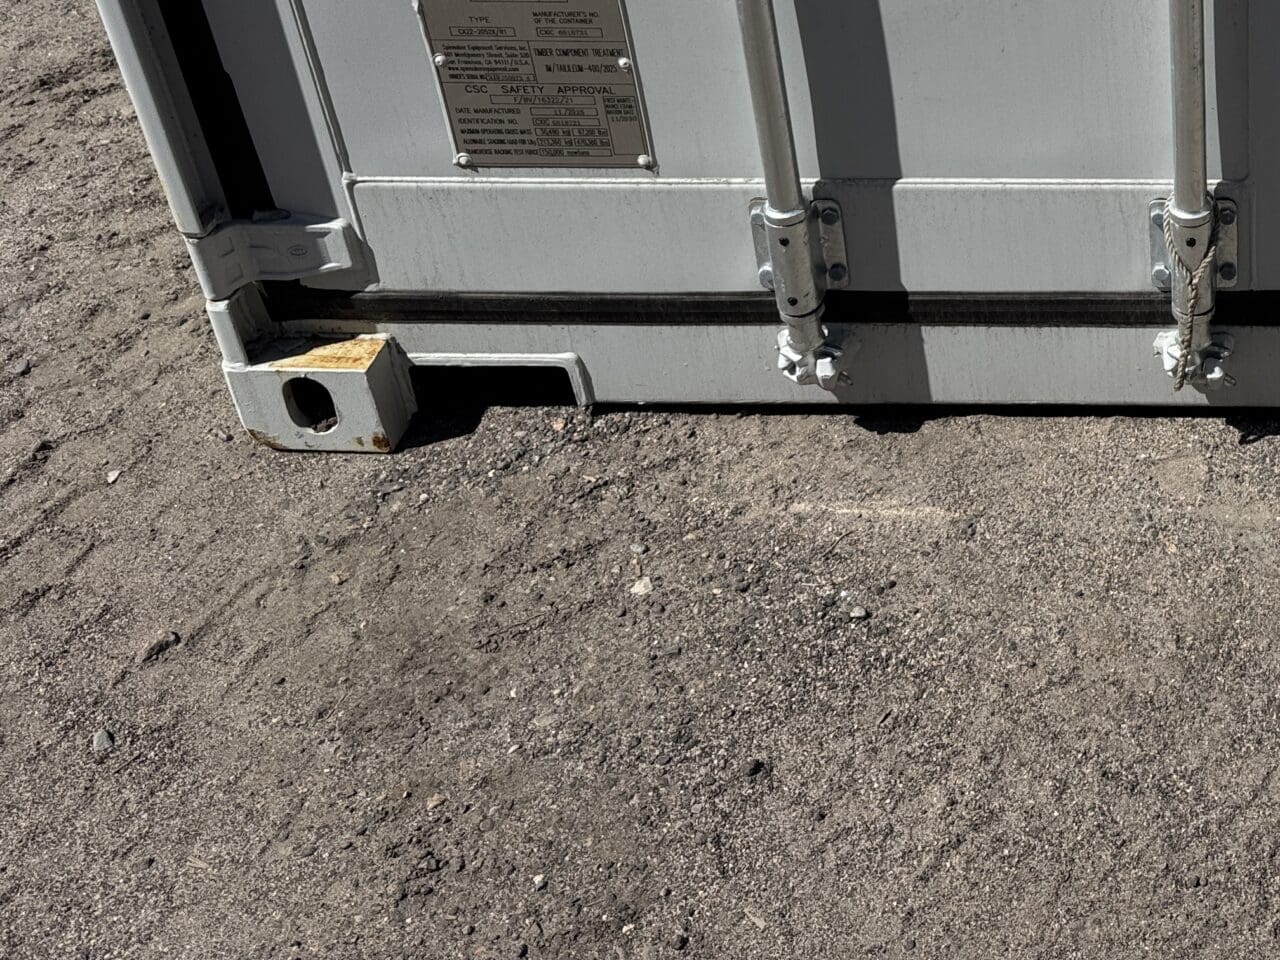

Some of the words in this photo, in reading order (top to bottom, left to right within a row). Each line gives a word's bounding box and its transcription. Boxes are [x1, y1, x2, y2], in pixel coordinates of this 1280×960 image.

[468, 16, 491, 24] TYPE
[533, 47, 554, 57] TIMBER
[555, 47, 589, 57] COMPONENT
[592, 47, 625, 58] TREATMENT
[464, 85, 489, 94] CSC
[500, 85, 545, 95] SAFETY
[557, 85, 616, 96] APPROVAL
[473, 107, 521, 115] MANUFACTURED
